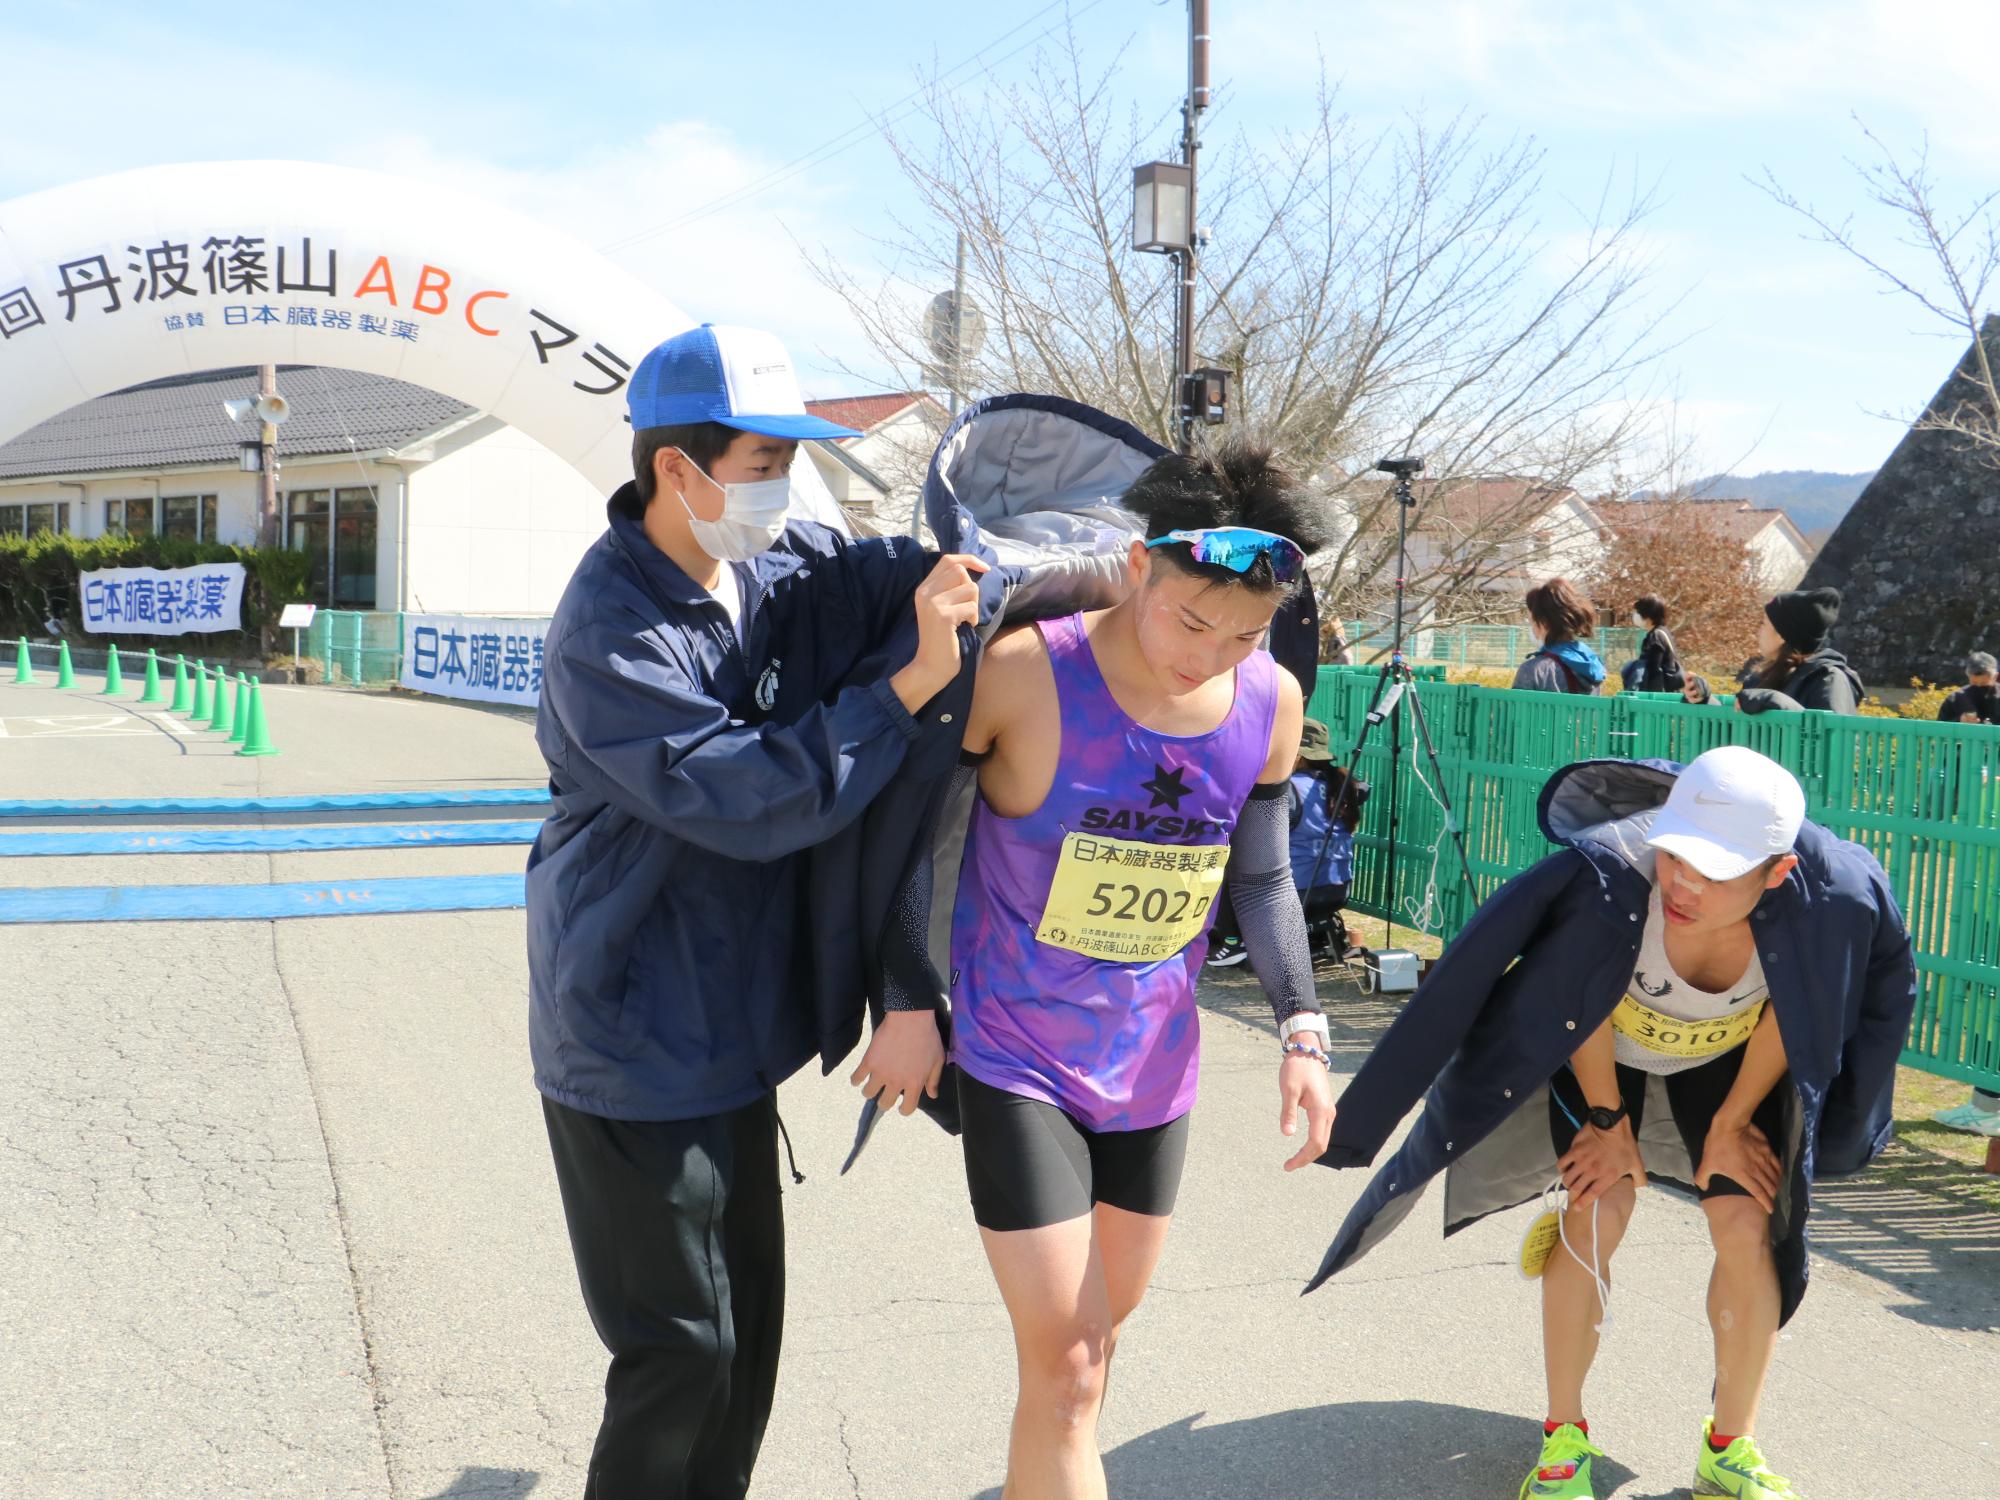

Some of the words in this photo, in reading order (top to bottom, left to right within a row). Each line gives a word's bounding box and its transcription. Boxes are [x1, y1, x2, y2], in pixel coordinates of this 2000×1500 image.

[164, 312, 205, 331] 協賛
[224, 304, 420, 342] 日本臓器製薬
[85, 574, 231, 624] 日本臓器製薬
[1074, 838, 1220, 873] 日本臓器製薬
[1636, 1021, 1728, 1046] 3010
